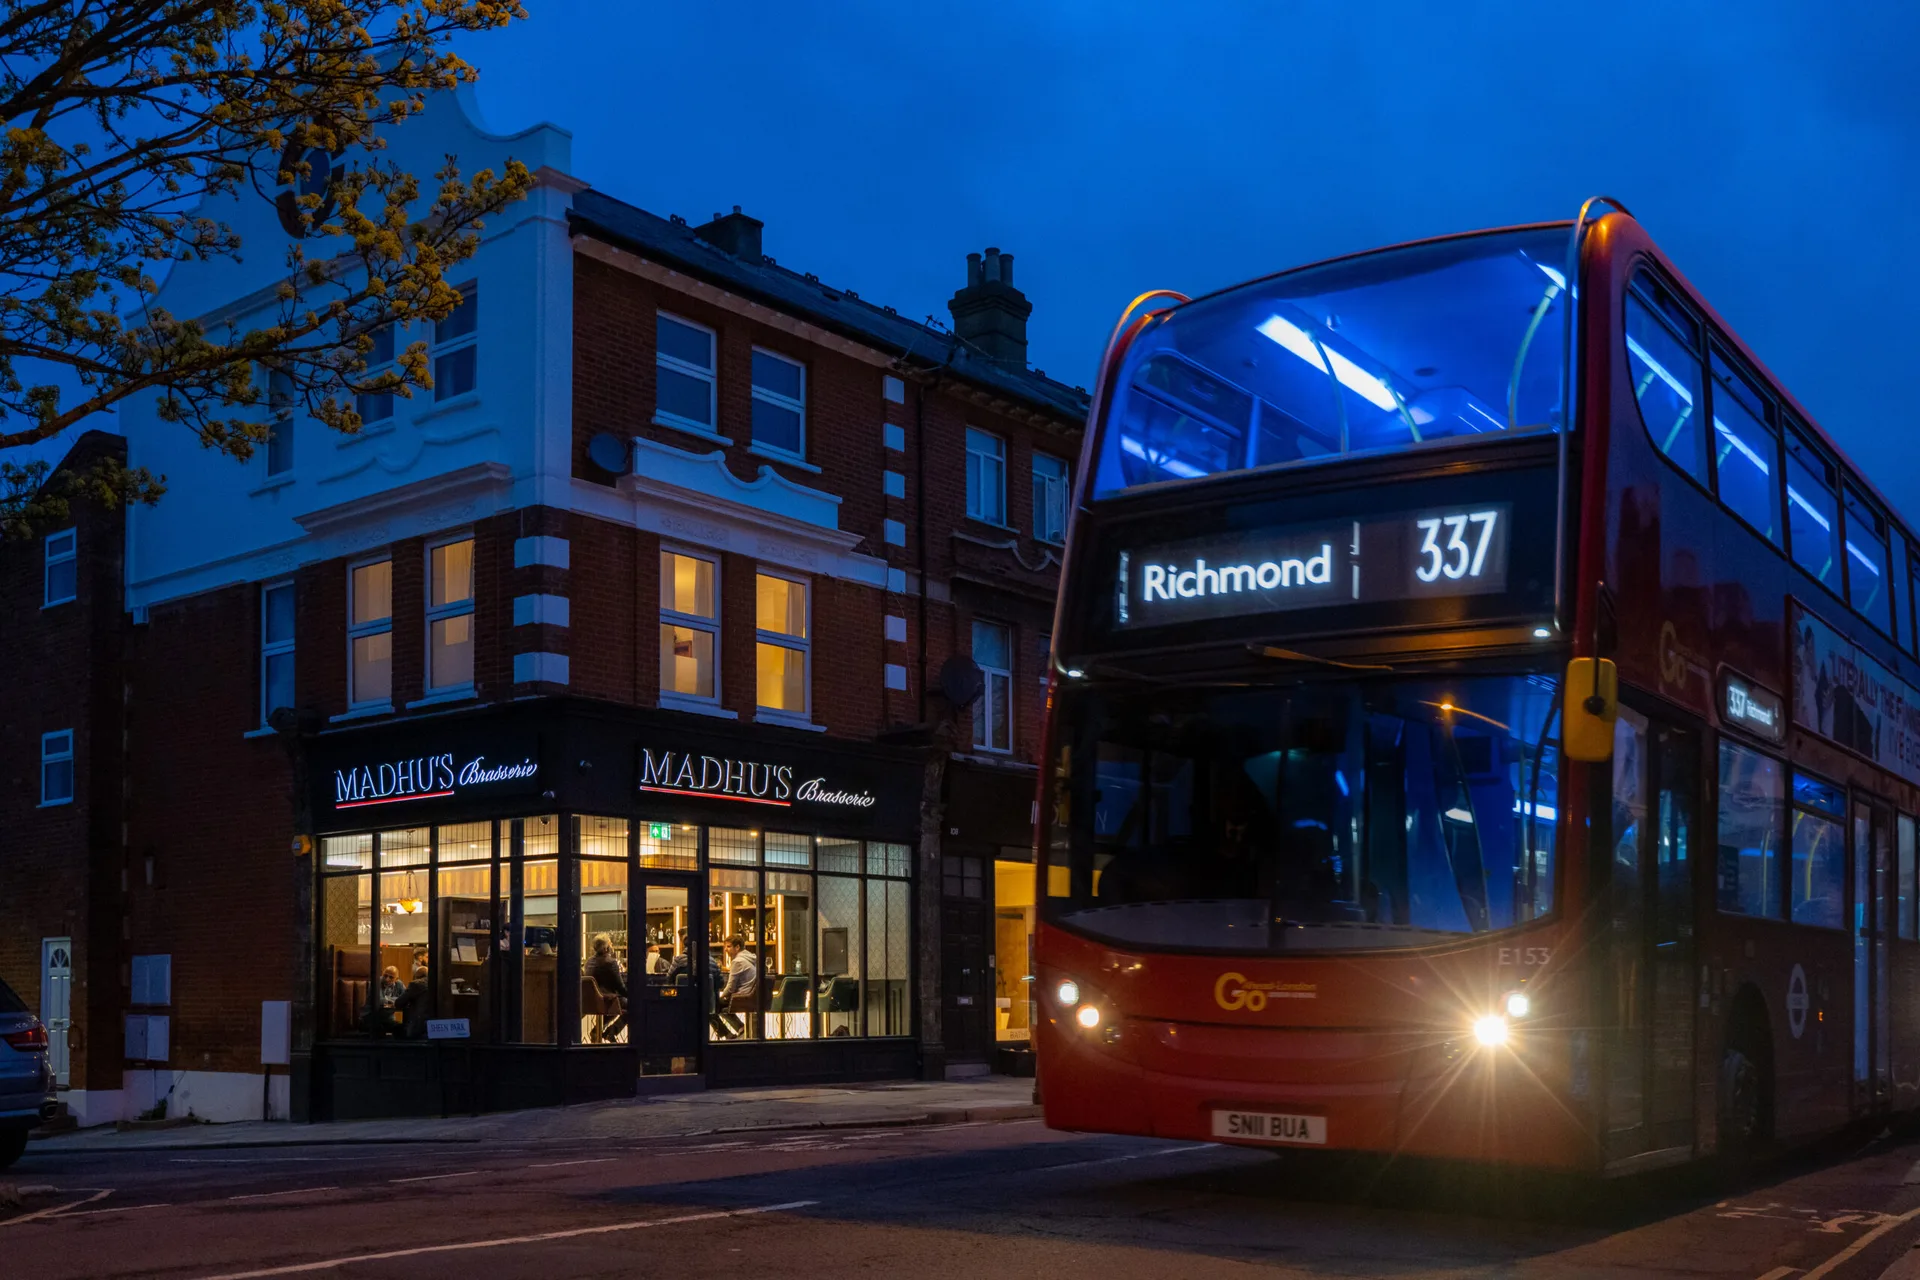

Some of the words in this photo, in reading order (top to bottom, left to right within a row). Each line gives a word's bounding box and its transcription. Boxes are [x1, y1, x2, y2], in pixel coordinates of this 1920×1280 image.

[1416, 511, 1498, 583] 337
[1143, 544, 1332, 602] Richmond
[336, 753, 454, 802] MADHU'S
[459, 756, 539, 786] Brasserie
[640, 748, 793, 800] MADHU'S
[796, 777, 876, 808] Brasserie
[1499, 947, 1550, 965] E153
[1214, 971, 1267, 1012] Go
[1270, 1116, 1310, 1139] BUA
